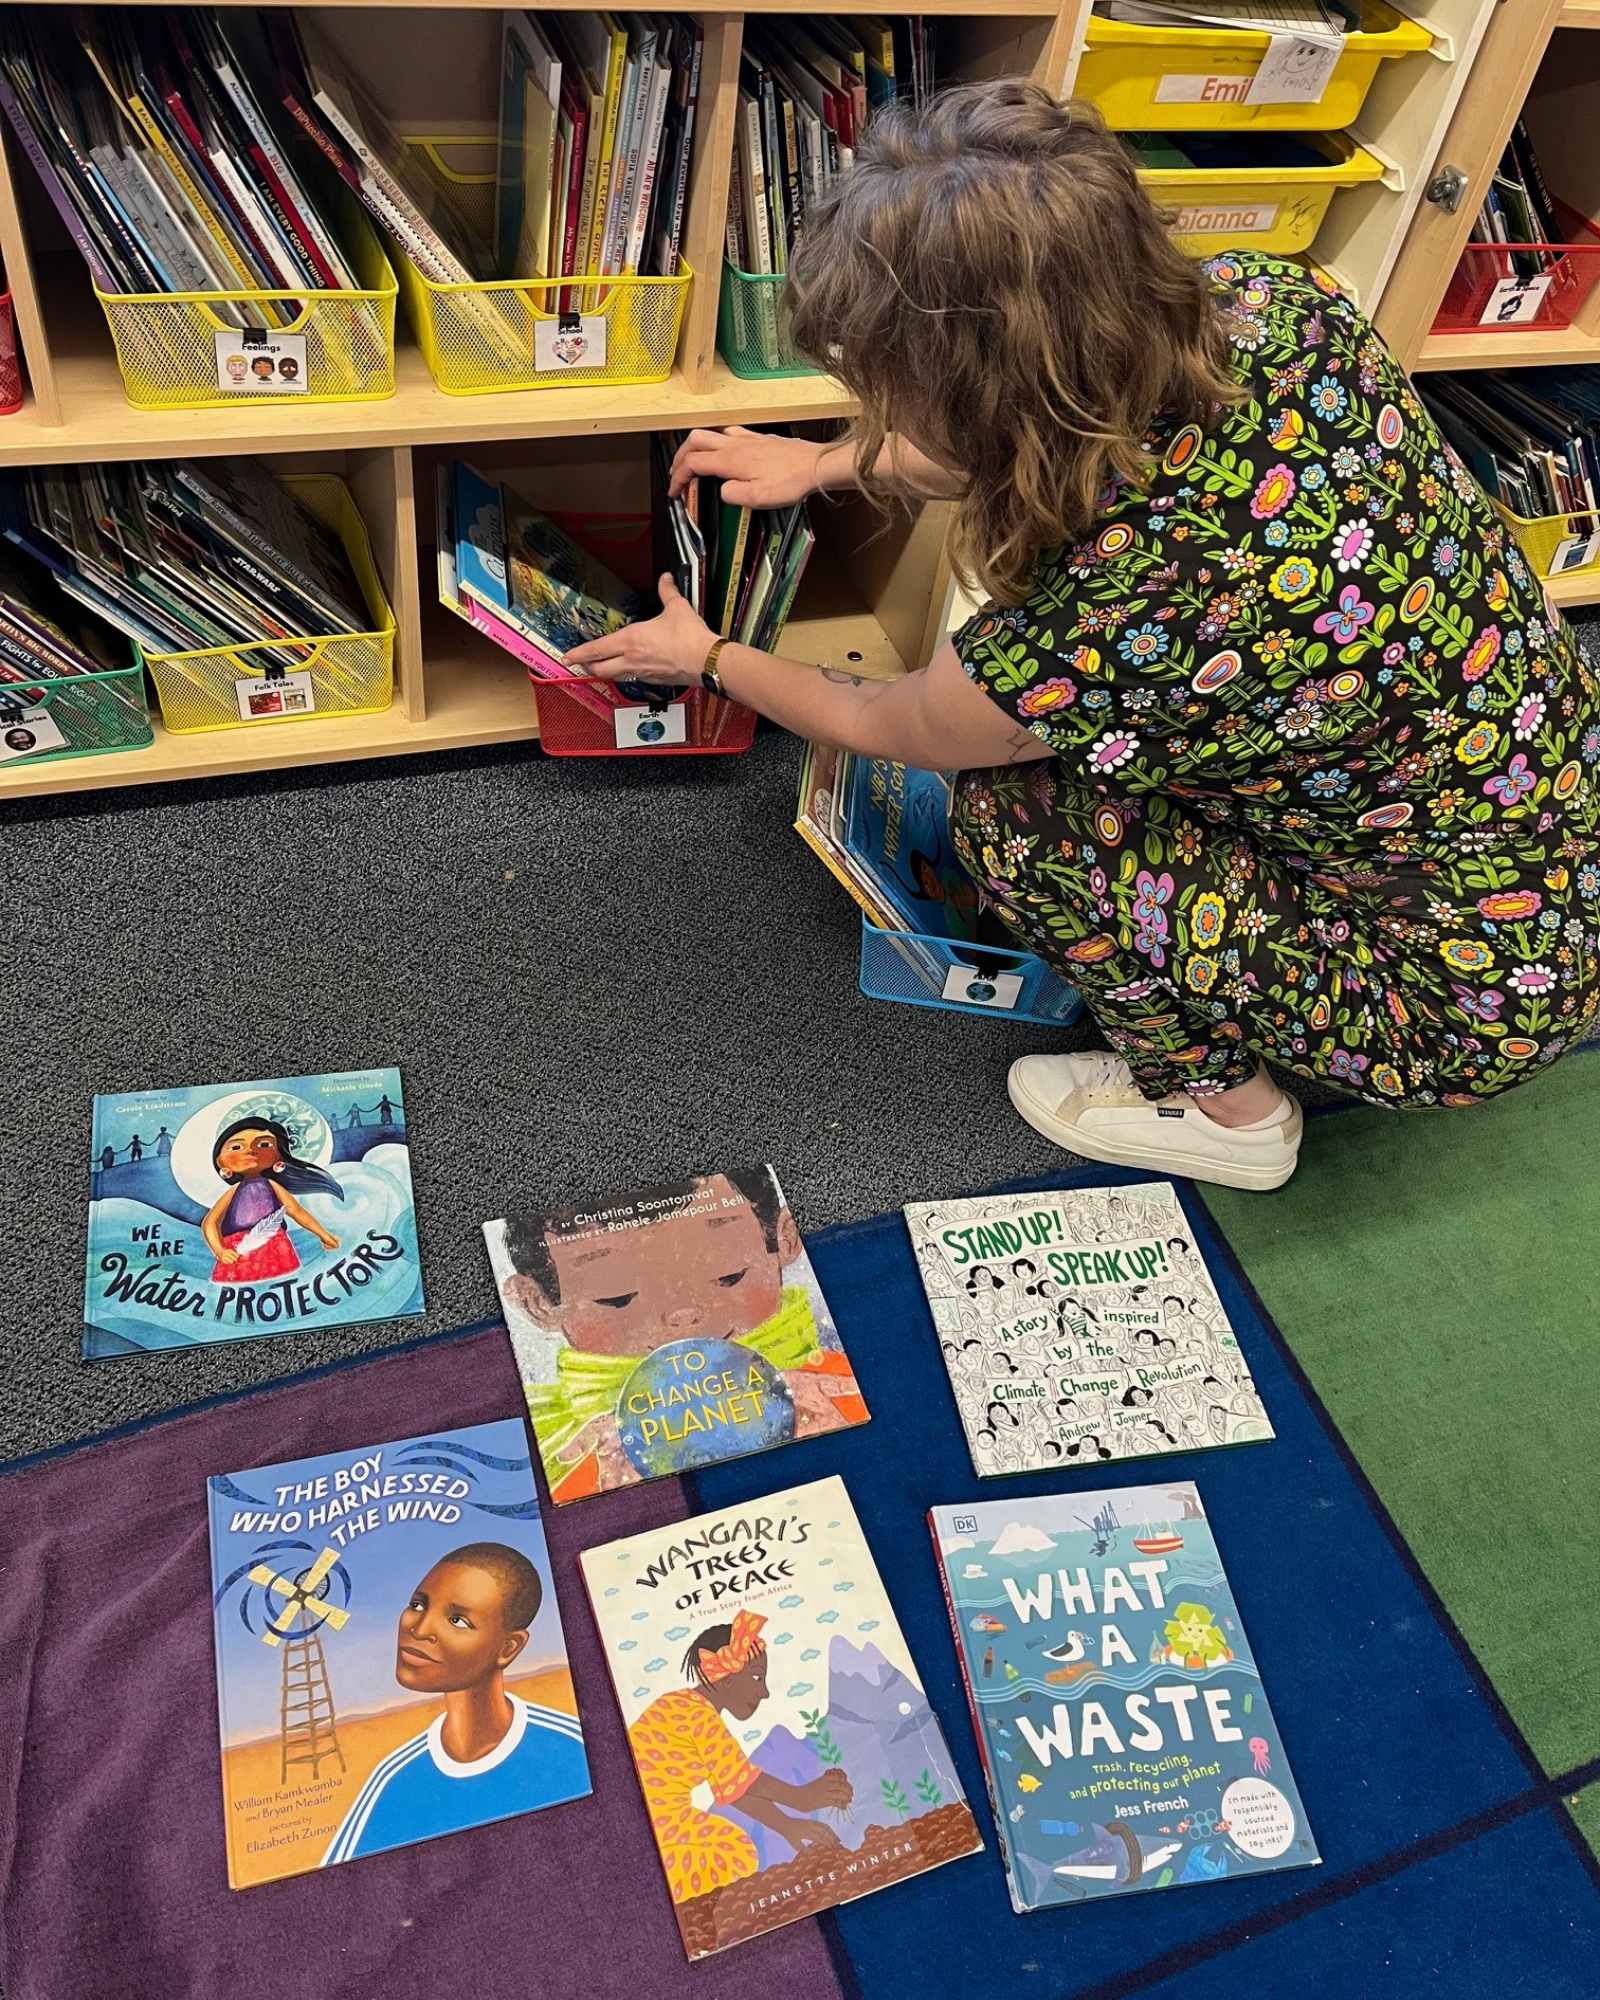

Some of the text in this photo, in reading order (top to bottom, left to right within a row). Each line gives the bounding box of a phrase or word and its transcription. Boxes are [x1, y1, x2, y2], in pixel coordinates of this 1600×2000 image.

[636, 66, 650, 120] Beaty Roberts
[135, 106, 155, 130] BANG
[227, 81, 270, 145] Alexandra Penfold
[329, 110, 358, 144] WINTER
[651, 85, 667, 149] Alexandra Penfold
[785, 114, 797, 168] Mo Willems
[158, 140, 177, 163] When
[171, 163, 193, 189] Sophie
[189, 189, 204, 206] Gets
[268, 152, 285, 173] BIG
[586, 157, 596, 175] The
[627, 147, 637, 172] SOFIA
[366, 158, 413, 213] NASREEN'S
[409, 212, 441, 249] SECRET
[580, 179, 593, 212] Pigeon
[590, 158, 610, 263] THE RECESS QUEEN
[636, 159, 656, 233] All Are Welcome
[667, 136, 690, 276] Our Favorite Day of the Year
[757, 198, 765, 222] THE
[261, 185, 275, 202] AM
[271, 202, 293, 232] EVERY
[288, 231, 307, 257] GOOD
[302, 255, 326, 288] THING
[577, 236, 586, 246] to
[579, 215, 589, 233] HAS
[617, 209, 628, 241] FUTURE
[759, 226, 767, 254] LION
[575, 249, 584, 262] Go
[613, 242, 623, 263] PREZ
[575, 266, 582, 275] to
[242, 342, 281, 353] Feelings
[558, 326, 583, 335] School
[166, 502, 184, 517] Find
[739, 516, 748, 545] NELSON
[231, 554, 282, 594] STAR WARS
[0, 638, 32, 663] FIGHTS
[30, 658, 44, 670] for
[40, 665, 71, 688] EQU
[25, 637, 42, 652] BIG
[40, 648, 70, 672] WORDS
[519, 651, 533, 662] HAVE
[532, 660, 546, 671] YOU
[18, 715, 47, 725] Stories
[891, 760, 906, 800] SON
[884, 795, 904, 862] WATER
[844, 881, 861, 900] Ada's
[859, 898, 877, 918] Violin
[321, 1082, 356, 1093] Michaela
[115, 1099, 186, 1113] Carole Lindstrom
[538, 1194, 744, 1247] ILLUSTRATED BY Rahele Jomepour Bell
[573, 1206, 634, 1226] Christina
[637, 1188, 715, 1211] Soontornvat
[131, 1223, 162, 1242] WE
[145, 1239, 185, 1258] ARE
[942, 1210, 1064, 1264] STAND UP!
[100, 1229, 405, 1324] Water PROTECTORS
[1047, 1240, 1169, 1287] SPEAK UP!
[1001, 1310, 1160, 1343] A story inspired
[666, 1351, 707, 1376] TO
[1053, 1341, 1114, 1361] by the
[627, 1365, 765, 1416] CHANGE A
[992, 1361, 1202, 1402] Climate Change Revolution
[639, 1390, 766, 1447] PLANET
[1058, 1410, 1153, 1442] Andrew Joyner
[274, 1451, 385, 1507] THE BOY
[229, 1472, 470, 1534] WHO HARNESSED
[329, 1502, 462, 1548] THE WIND
[957, 1518, 974, 1531] DK
[636, 1515, 812, 1589] WANGARI'S
[685, 1541, 767, 1580] TREES
[675, 1558, 798, 1610] OF PEACE
[689, 1582, 793, 1620] A True Story from Africa
[1002, 1559, 1169, 1624] WHAT
[936, 1560, 961, 1646] WHAT A WASTE
[1101, 1624, 1139, 1668] A
[959, 1659, 976, 1715] Jess French
[1014, 1685, 1244, 1768] WASTE
[233, 1777, 343, 1812] William Kamkwamba
[1069, 1761, 1221, 1799] and protecting our planet
[1240, 1793, 1259, 1802] made
[1260, 1791, 1277, 1799] with
[245, 1792, 334, 1824] and Bryan Mealer
[269, 1814, 314, 1834] pictures by
[1114, 1795, 1190, 1818] Jess French
[1233, 1803, 1278, 1815] responsibly
[1244, 1813, 1275, 1825] sourced
[246, 1822, 338, 1854] Elizabeth Zunon
[1236, 1823, 1289, 1838] materials and
[1265, 1835, 1284, 1845] inks!
[749, 1842, 914, 1914] JEANETTE WINTER
